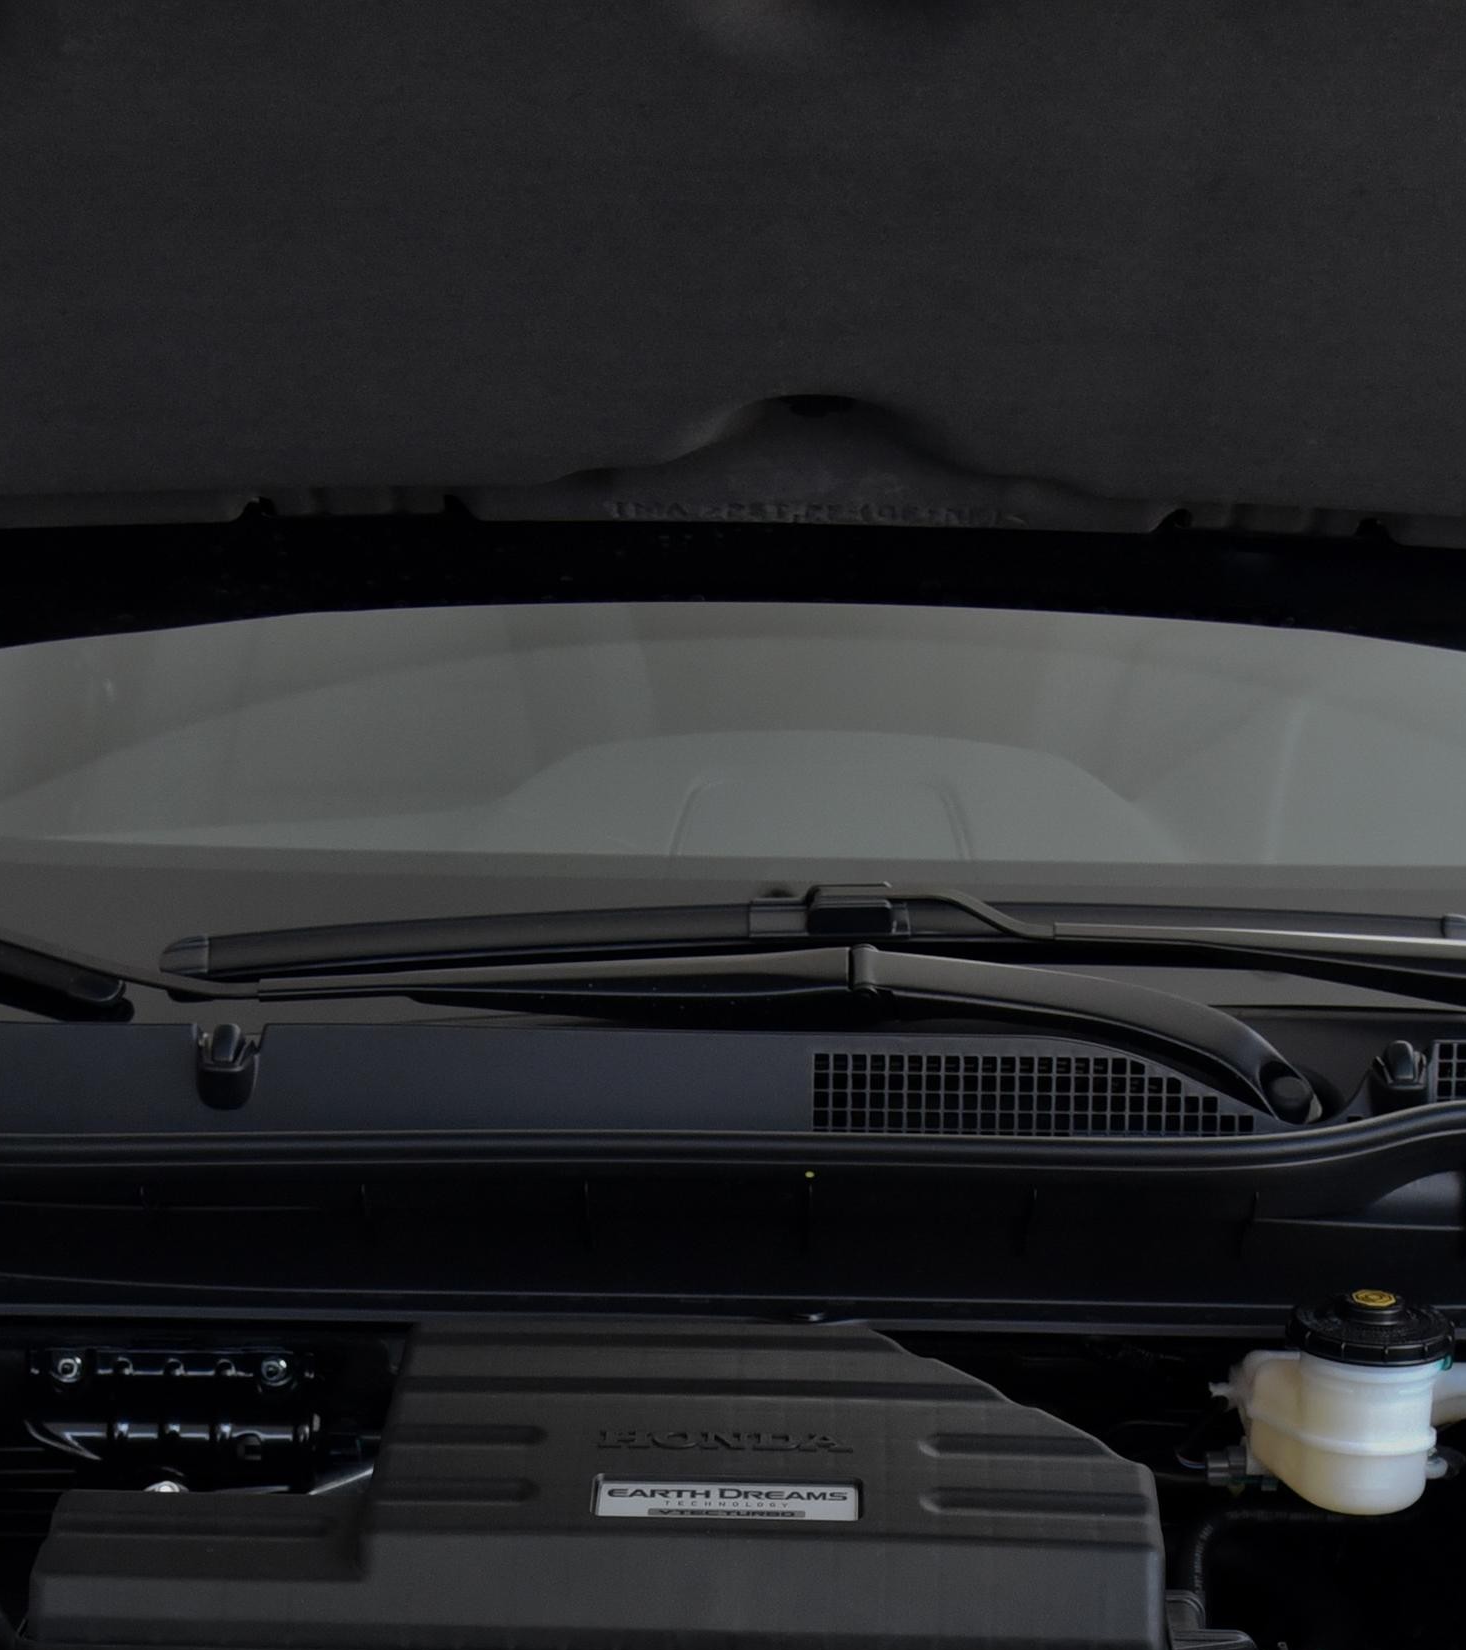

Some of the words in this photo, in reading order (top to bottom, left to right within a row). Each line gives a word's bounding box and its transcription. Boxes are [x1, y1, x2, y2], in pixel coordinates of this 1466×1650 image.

[596, 1430, 854, 1453] HONDA
[607, 1488, 710, 1500] EARTH
[718, 1487, 848, 1501] DREAMS
